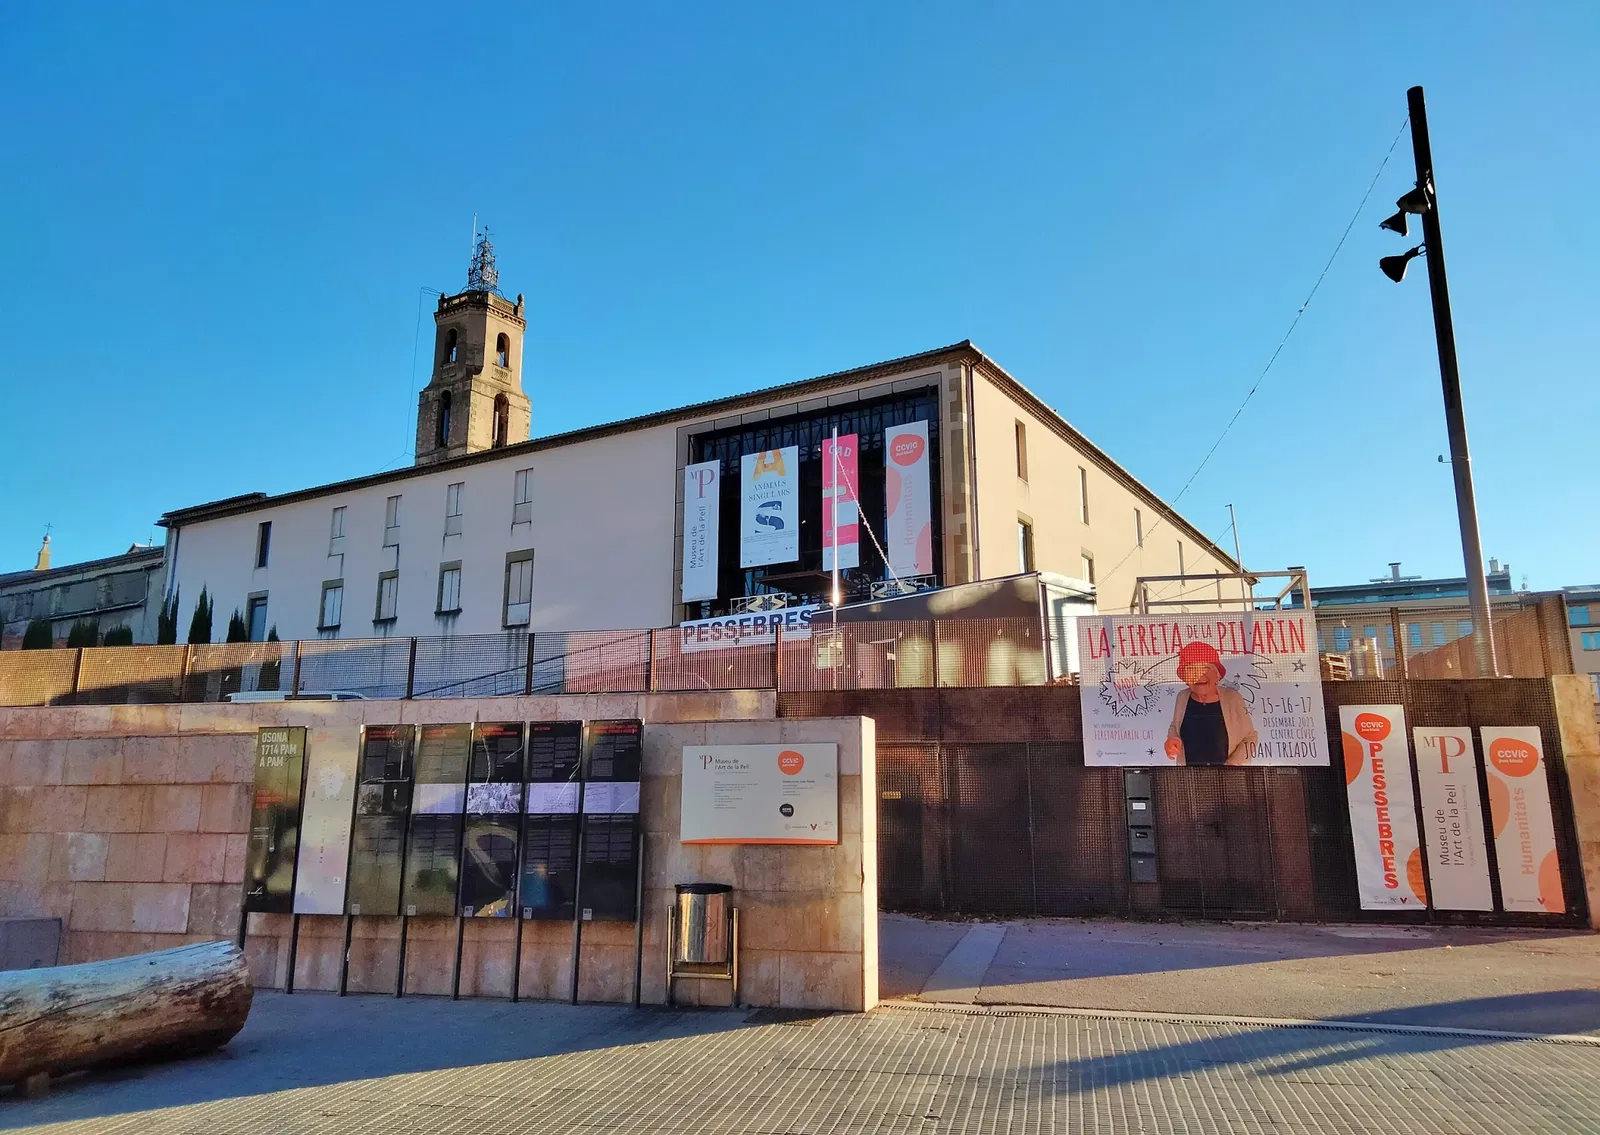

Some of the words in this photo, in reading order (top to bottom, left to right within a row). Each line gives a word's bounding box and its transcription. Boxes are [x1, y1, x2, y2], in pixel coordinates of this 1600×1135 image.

[895, 441, 918, 452] CCVIC
[754, 480, 787, 491] ANIMALS
[749, 489, 791, 502] SINGULARS
[698, 506, 706, 522] Pell
[903, 474, 914, 547] Humanitats
[689, 526, 698, 537] de
[698, 524, 706, 532] la
[698, 534, 706, 547] de
[690, 540, 698, 569] Museu
[683, 609, 813, 645] PESSEBRES
[1087, 627, 1111, 659] LA
[1117, 623, 1184, 657] FIRETA
[1186, 625, 1200, 639] DE
[1201, 624, 1213, 639] LA
[1216, 618, 1306, 655] PILARIN
[1113, 675, 1140, 692] NADAL
[1117, 692, 1125, 704] A
[1261, 696, 1312, 713] 15-16-17
[1263, 717, 1295, 728] DESEMBRE
[1297, 716, 1315, 728] 2023
[261, 732, 288, 743] OSONA
[1270, 729, 1294, 739] CENTRE
[261, 744, 280, 755] 1714
[280, 743, 297, 755] PAM
[1243, 741, 1273, 760] JOAN
[1275, 738, 1318, 759] TRIADÚ
[1497, 749, 1529, 759] CCVIC
[259, 756, 266, 768] A
[266, 756, 284, 768] PAM
[1445, 784, 1458, 804] Pell
[1368, 742, 1400, 889] PESSEBRES
[1434, 809, 1446, 824] de
[1448, 808, 1459, 818] la
[1450, 822, 1461, 837] de
[1514, 787, 1535, 875] Humanitats
[1439, 827, 1450, 866] Museu
[1453, 841, 1465, 866] l'Art
